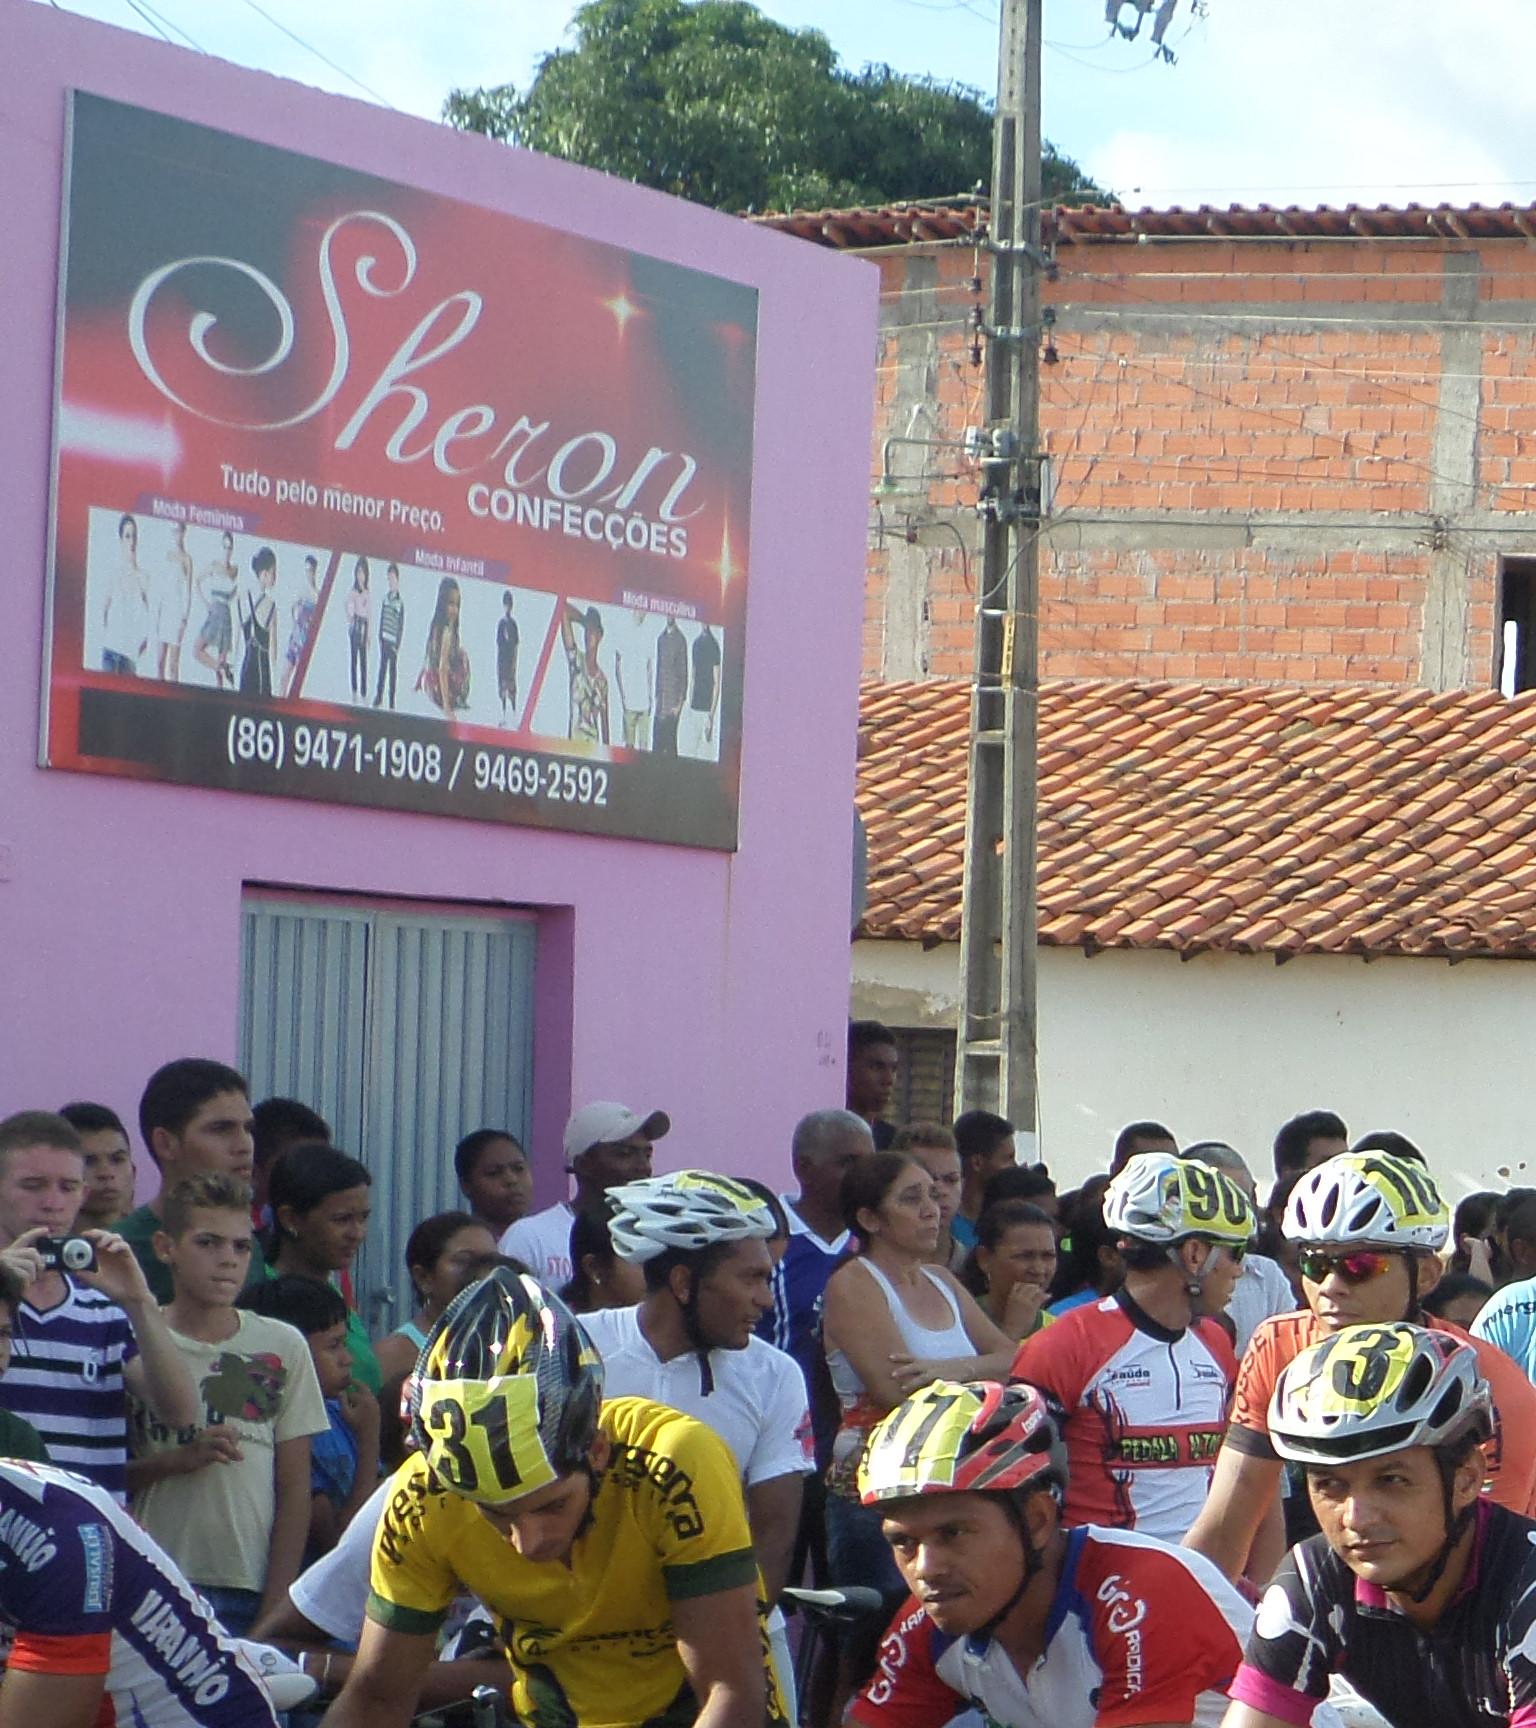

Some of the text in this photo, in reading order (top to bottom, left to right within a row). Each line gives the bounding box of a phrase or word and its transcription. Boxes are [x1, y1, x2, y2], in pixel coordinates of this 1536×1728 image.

[128, 210, 706, 522] Sheron
[220, 464, 445, 533] Tudo pelo menor Preço.
[466, 482, 687, 558] CONFECÇÕES
[227, 715, 284, 769] (86)
[293, 726, 442, 784] 9471-1908
[474, 751, 609, 806] 9469-2592
[1182, 1165, 1249, 1225] 90
[428, 1394, 523, 1491] 31
